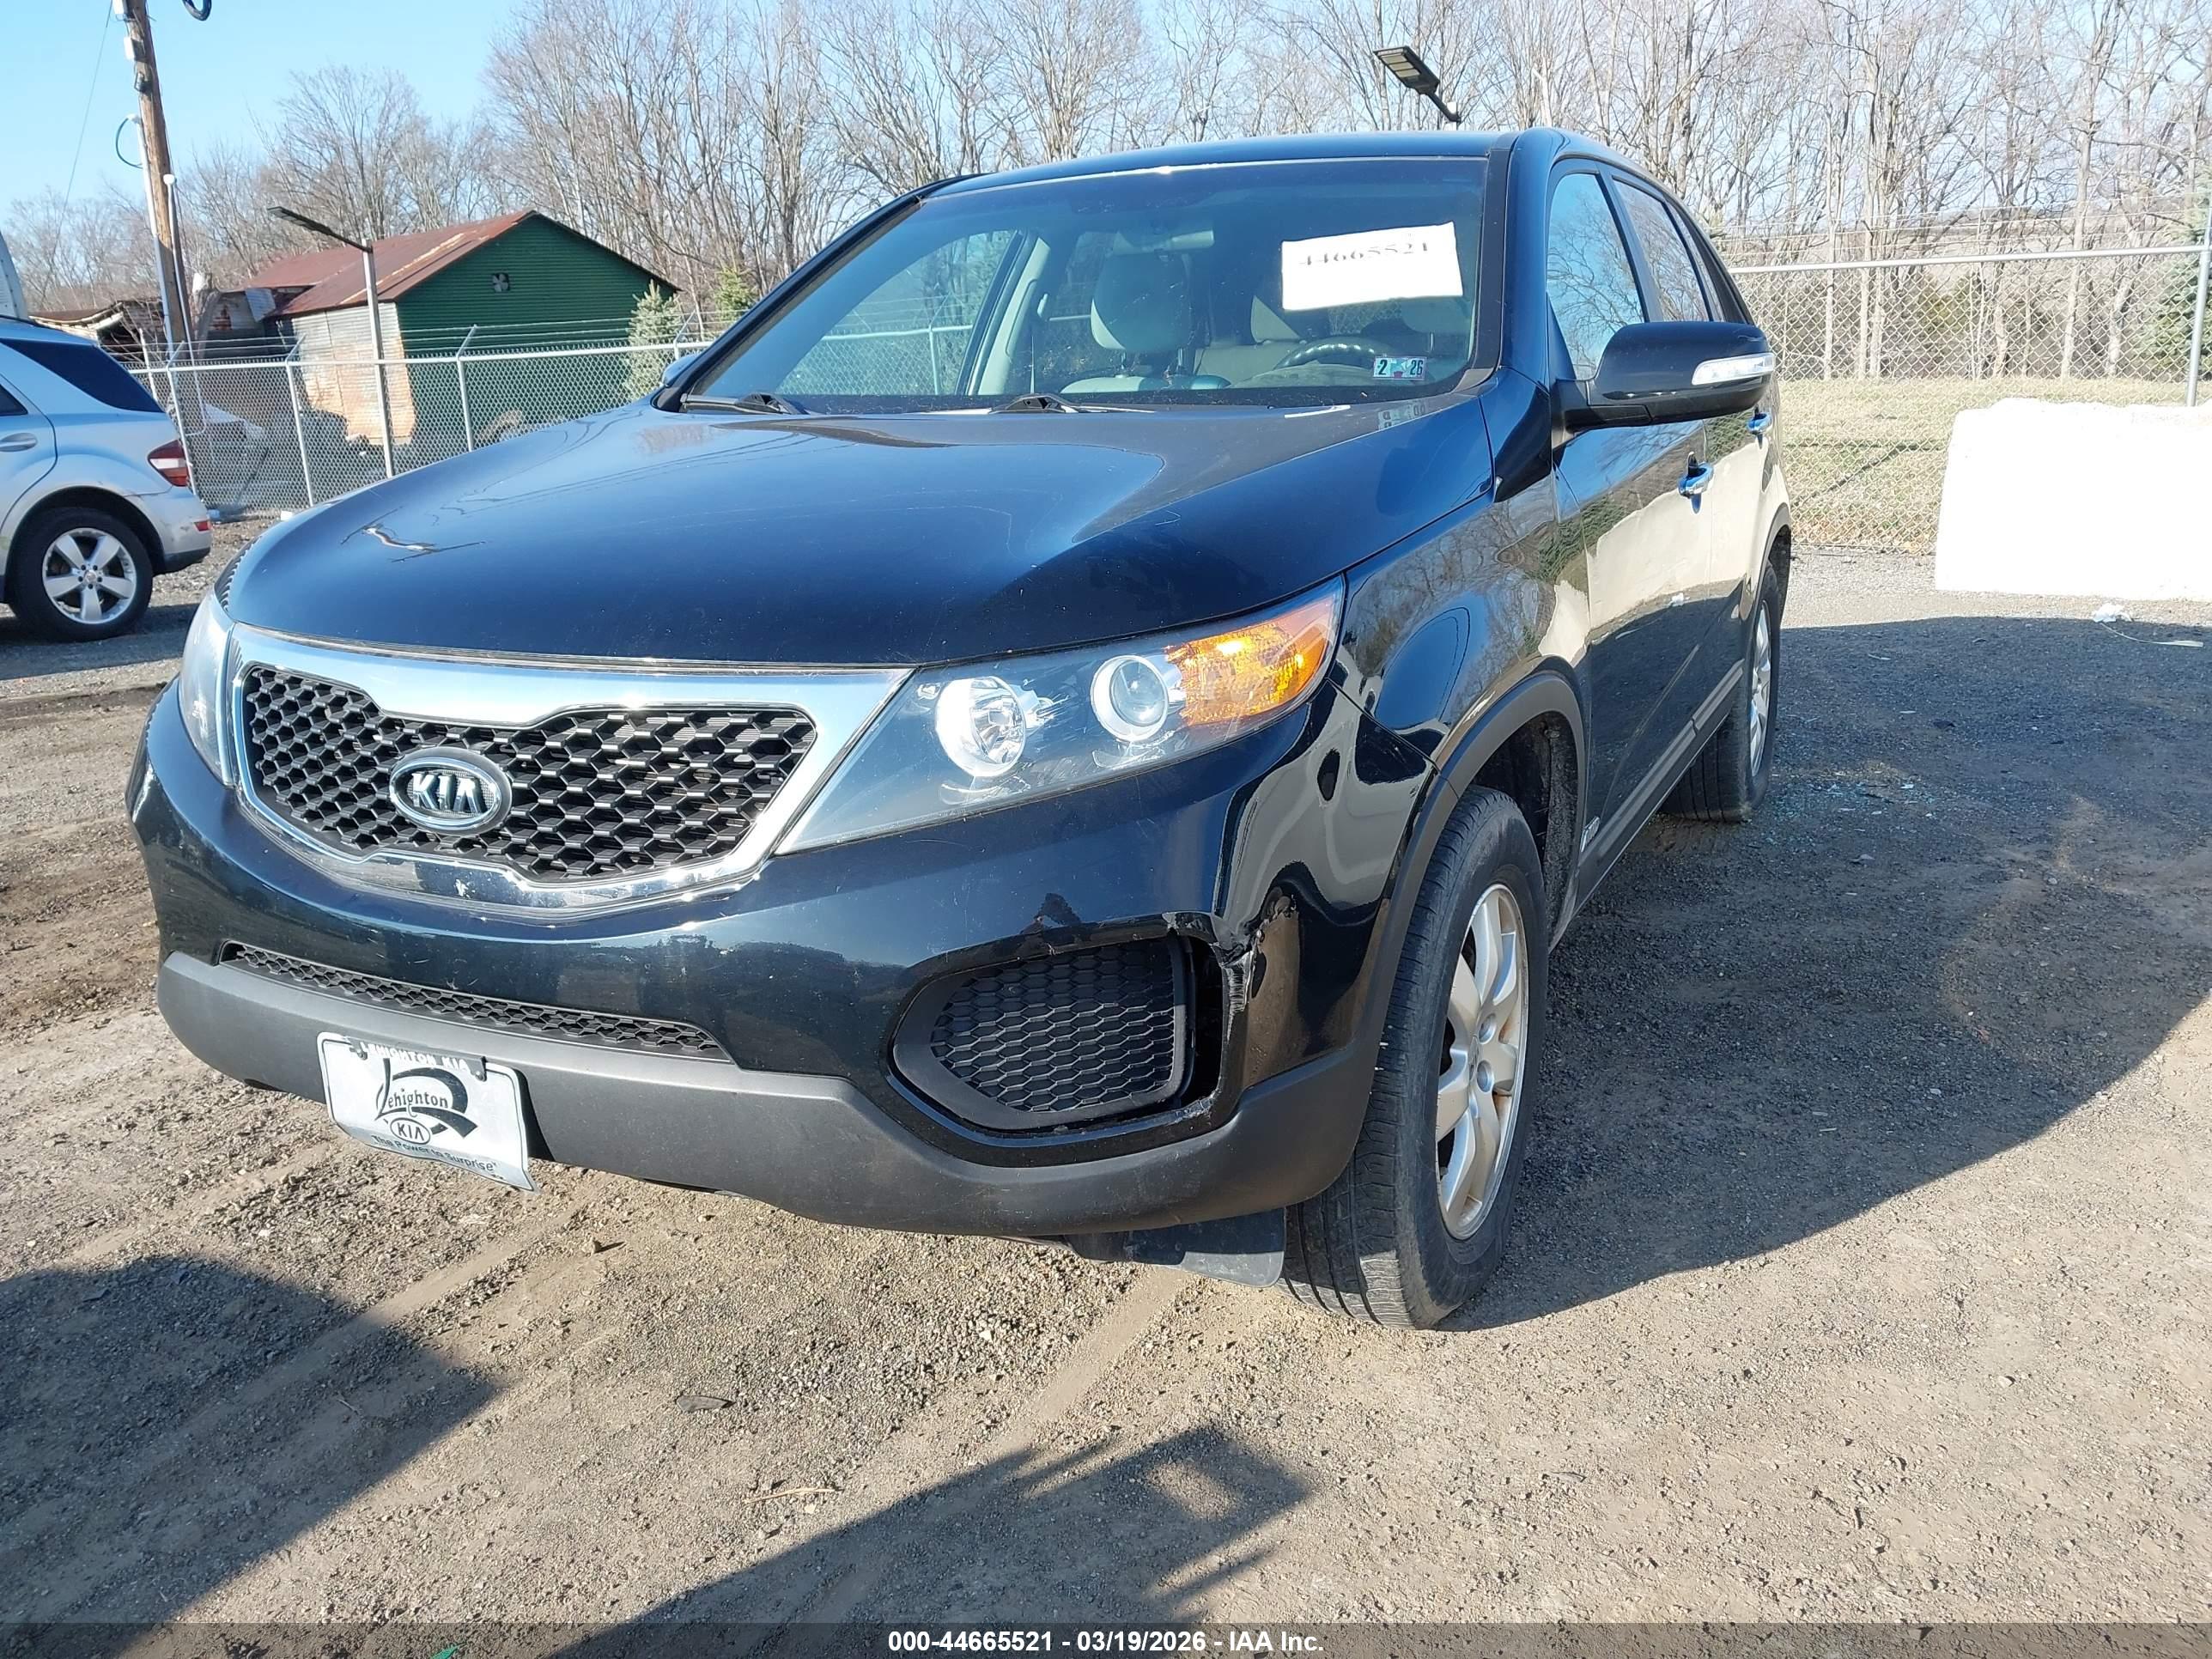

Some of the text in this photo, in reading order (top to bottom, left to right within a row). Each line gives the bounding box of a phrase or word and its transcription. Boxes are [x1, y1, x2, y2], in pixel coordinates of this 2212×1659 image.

[1377, 359, 1424, 375] 2 26
[411, 772, 483, 814] KIA
[397, 1127, 425, 1141] KIA
